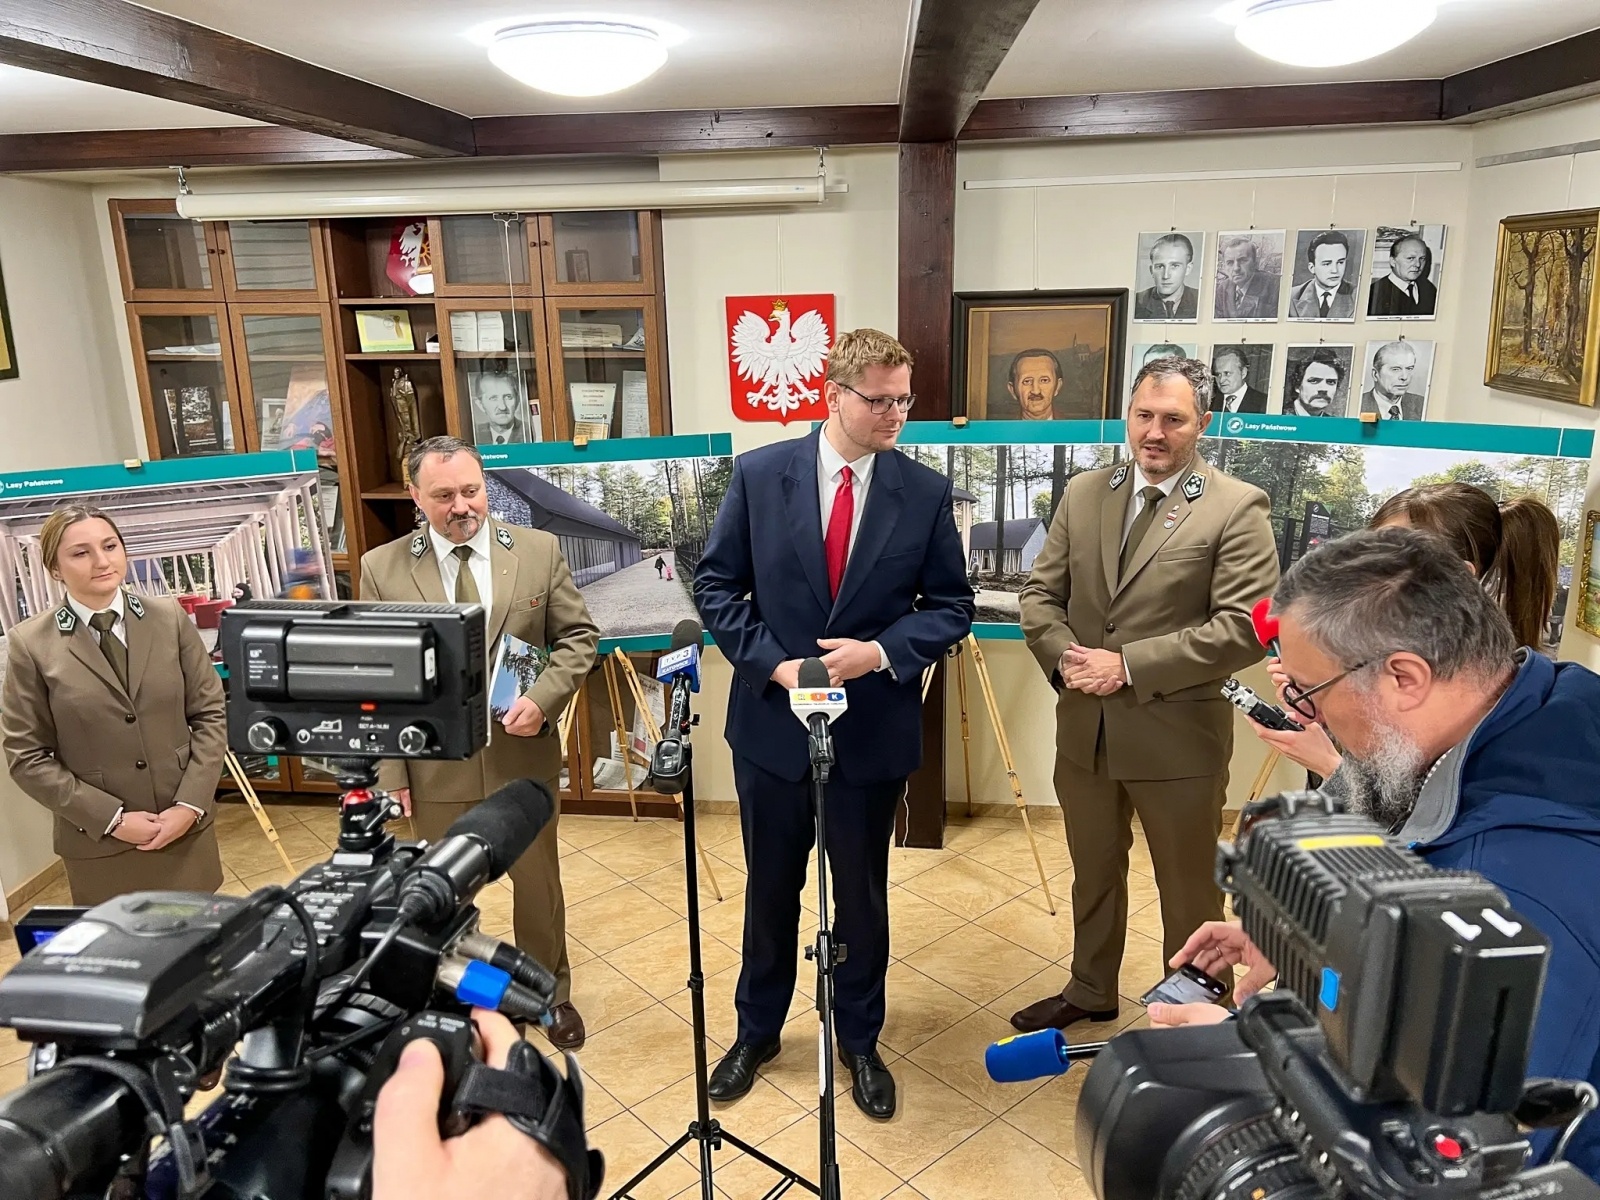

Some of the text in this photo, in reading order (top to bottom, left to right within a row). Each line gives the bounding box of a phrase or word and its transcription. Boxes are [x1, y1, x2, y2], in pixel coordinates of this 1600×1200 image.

[1244, 422, 1297, 432] Lasy Państwowe
[23, 479, 64, 487] Państwowe
